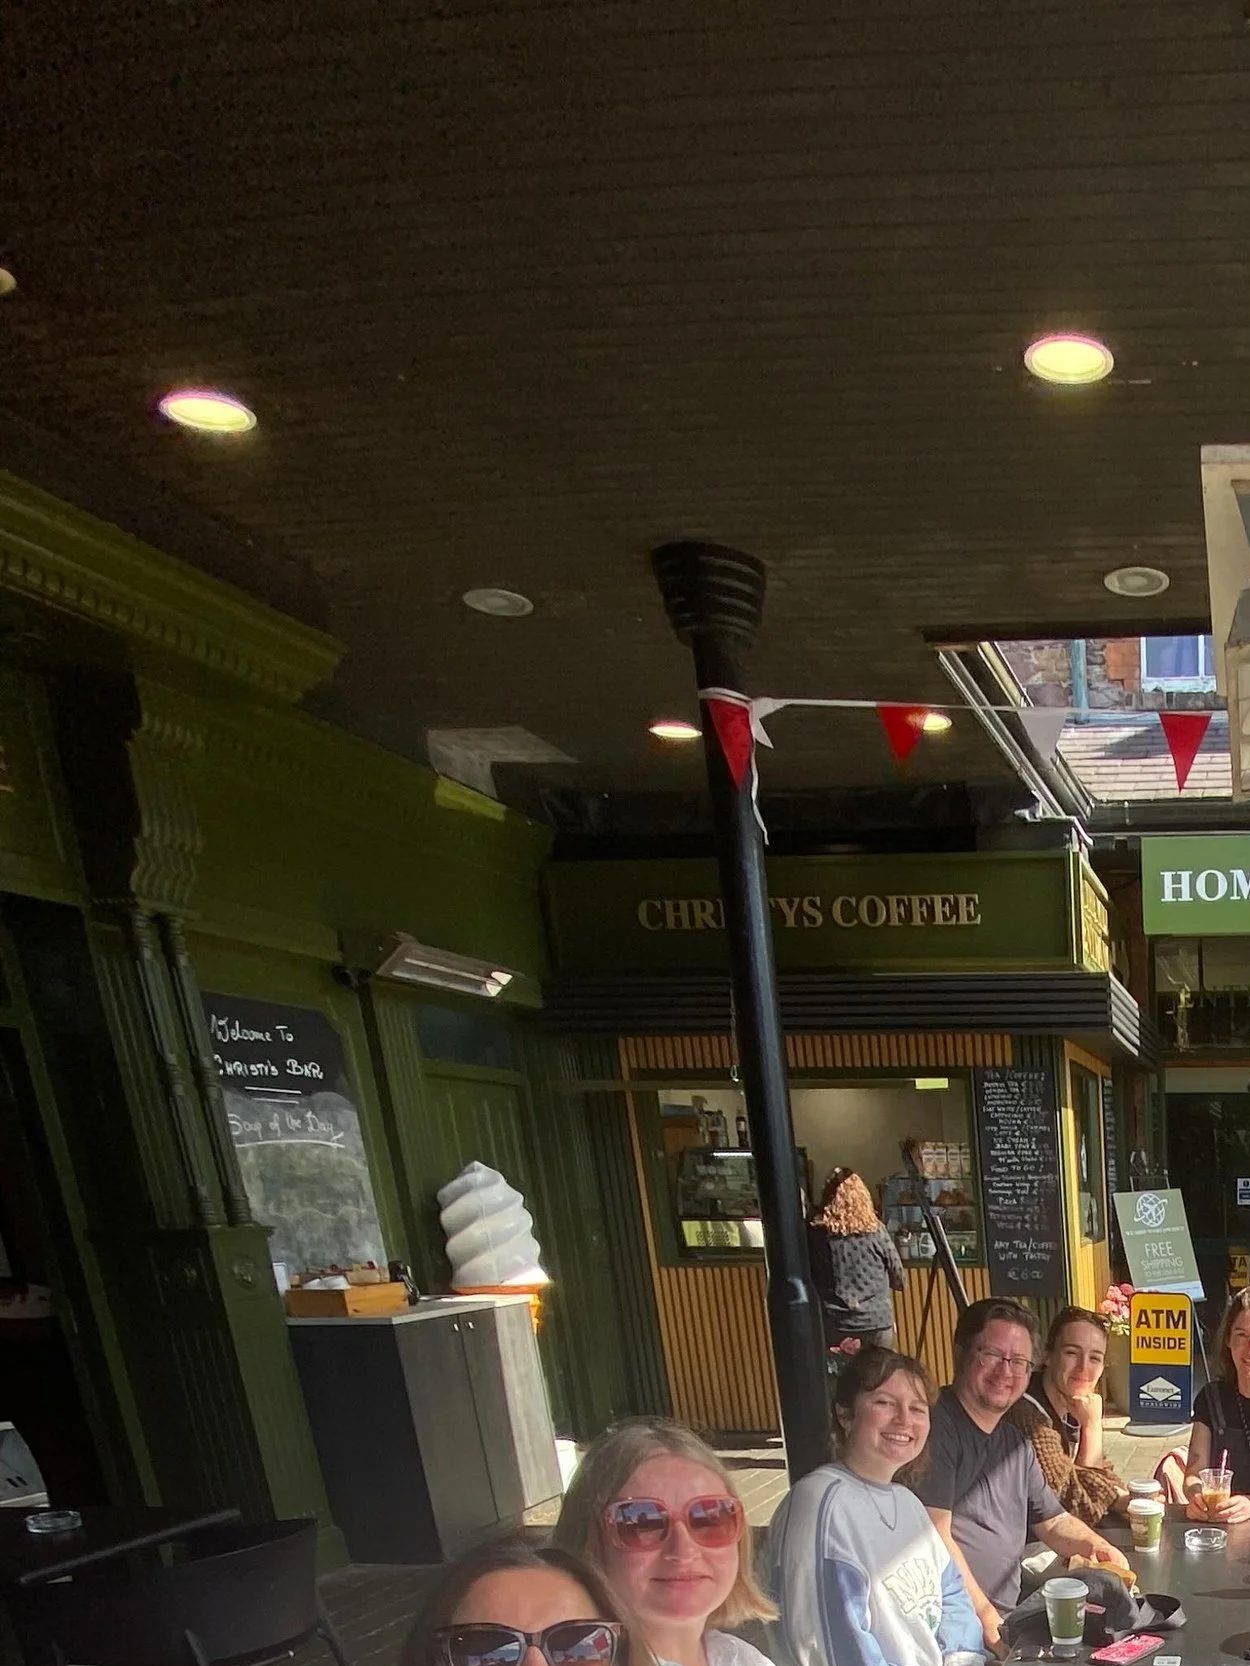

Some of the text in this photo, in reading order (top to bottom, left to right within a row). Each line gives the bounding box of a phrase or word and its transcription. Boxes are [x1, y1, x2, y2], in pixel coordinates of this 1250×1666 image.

[637, 893, 982, 930] CHRYS COFFEE
[210, 1014, 294, 1042] Welcome To
[286, 1059, 323, 1079] BAR
[269, 1112, 281, 1137] of
[1144, 1241, 1175, 1257] FREE
[1141, 1256, 1184, 1271] SHIPPING
[1135, 1309, 1187, 1330] ATM
[1136, 1336, 1187, 1350] INSIDE
